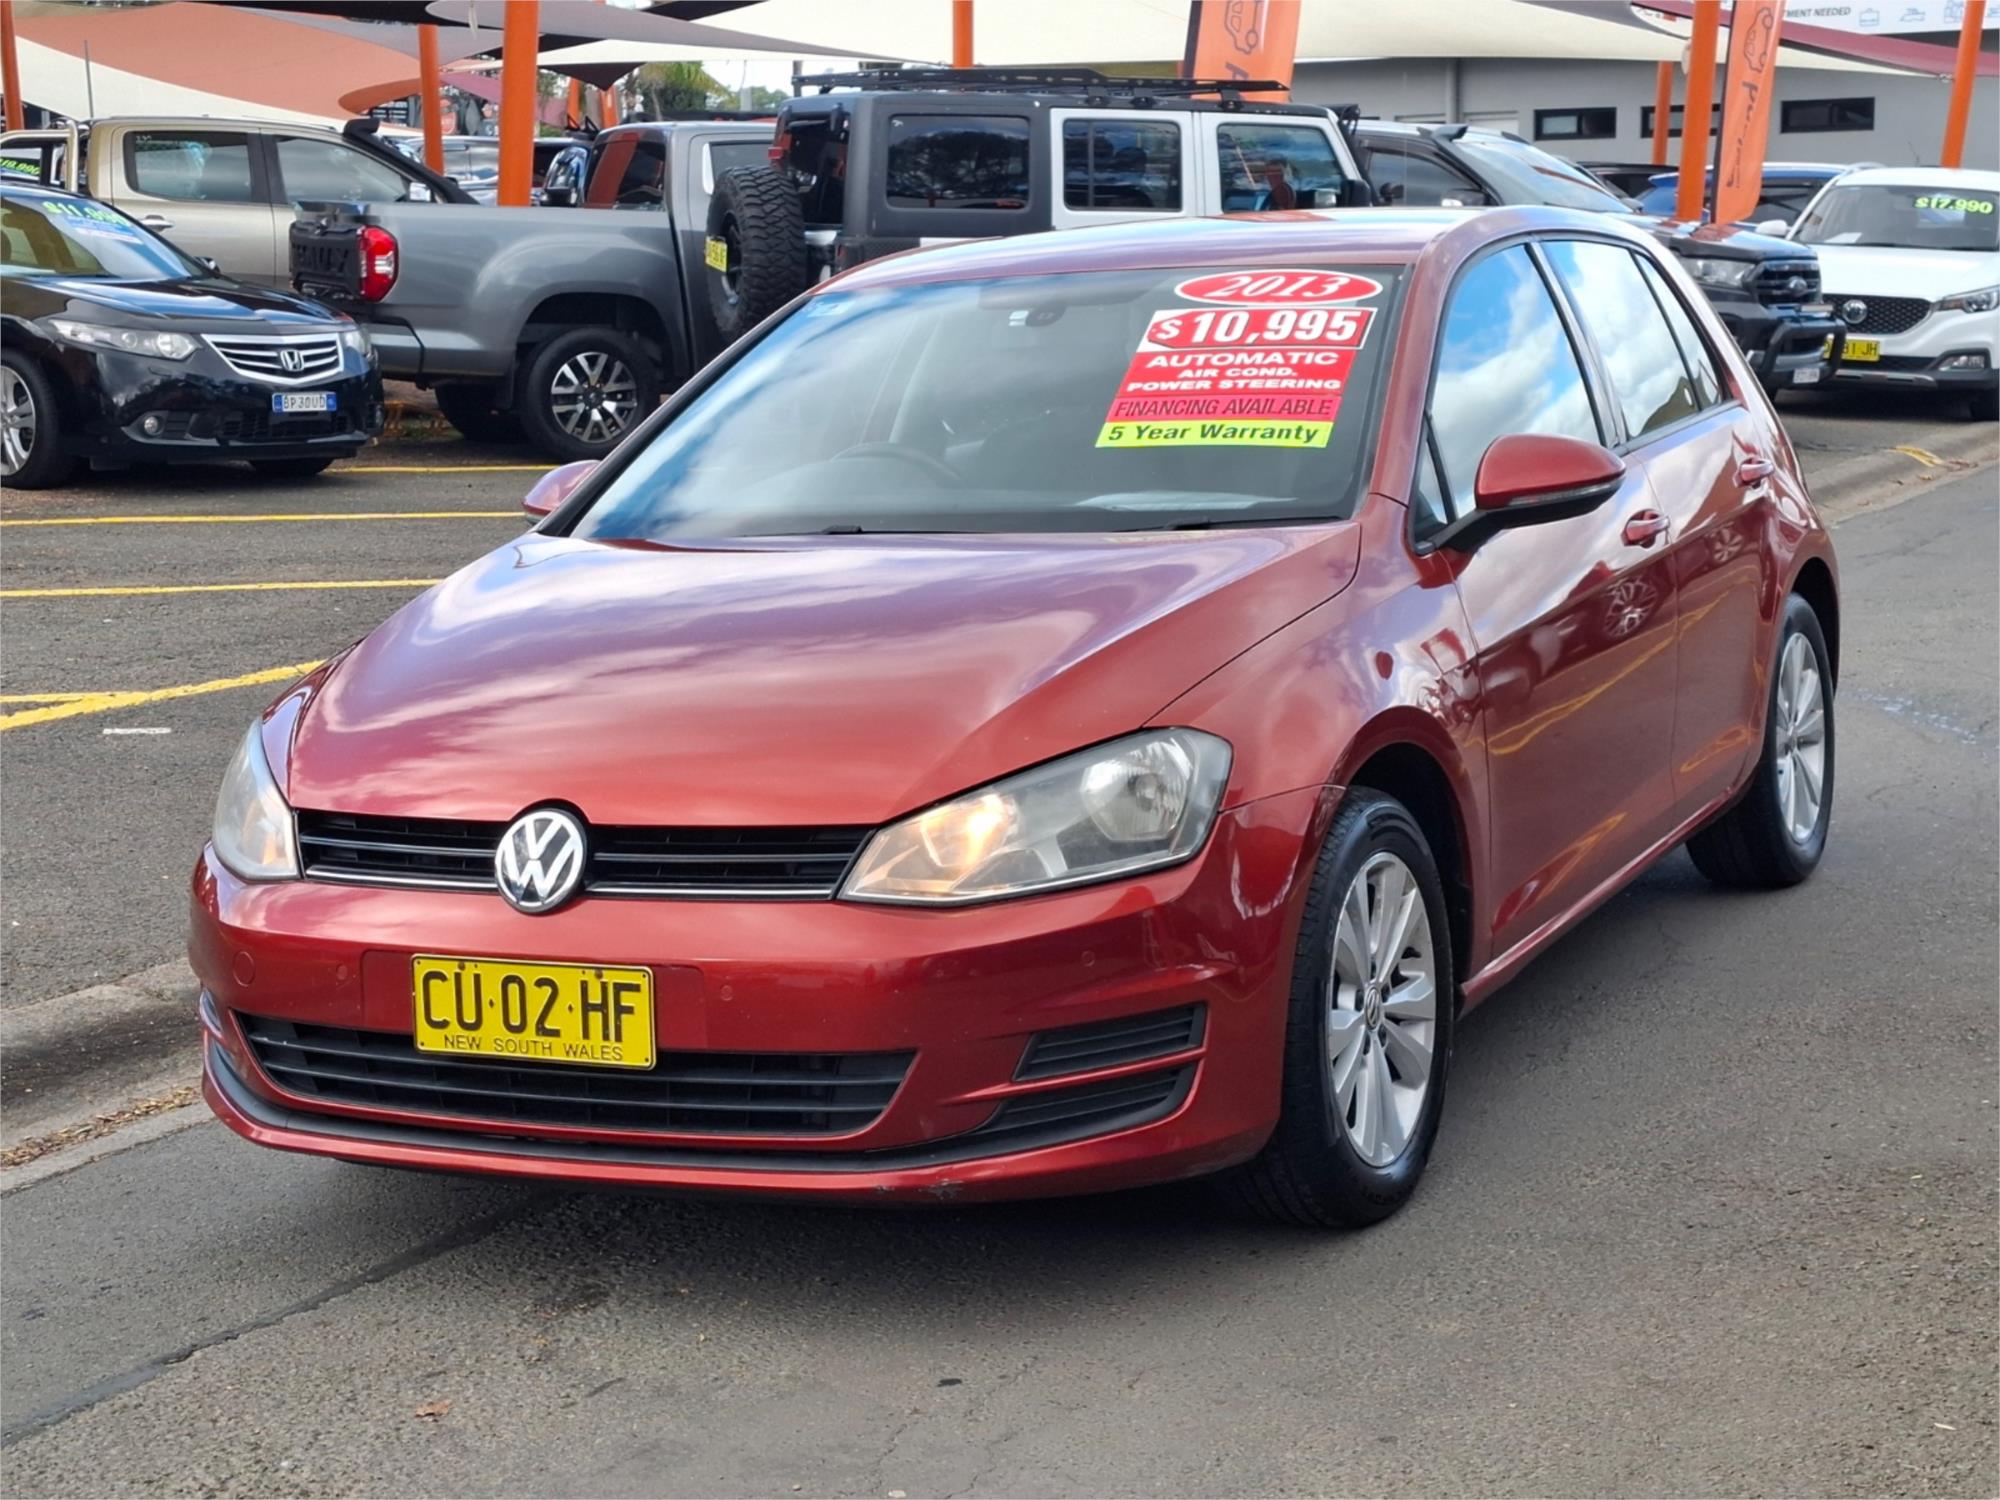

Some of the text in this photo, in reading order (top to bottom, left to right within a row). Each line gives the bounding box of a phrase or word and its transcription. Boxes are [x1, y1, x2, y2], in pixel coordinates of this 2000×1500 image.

[1204, 276, 1351, 297] 2013
[1146, 352, 1339, 368] AUTOMATIC
[1177, 367, 1299, 379] AIR COND.
[1127, 379, 1342, 392] POWER STEERING
[1114, 398, 1332, 418] FINANCING AVAILABLE
[1108, 424, 1318, 443] 5 Year Warranty
[444, 1034, 624, 1061] NEW SOUTH WALES
